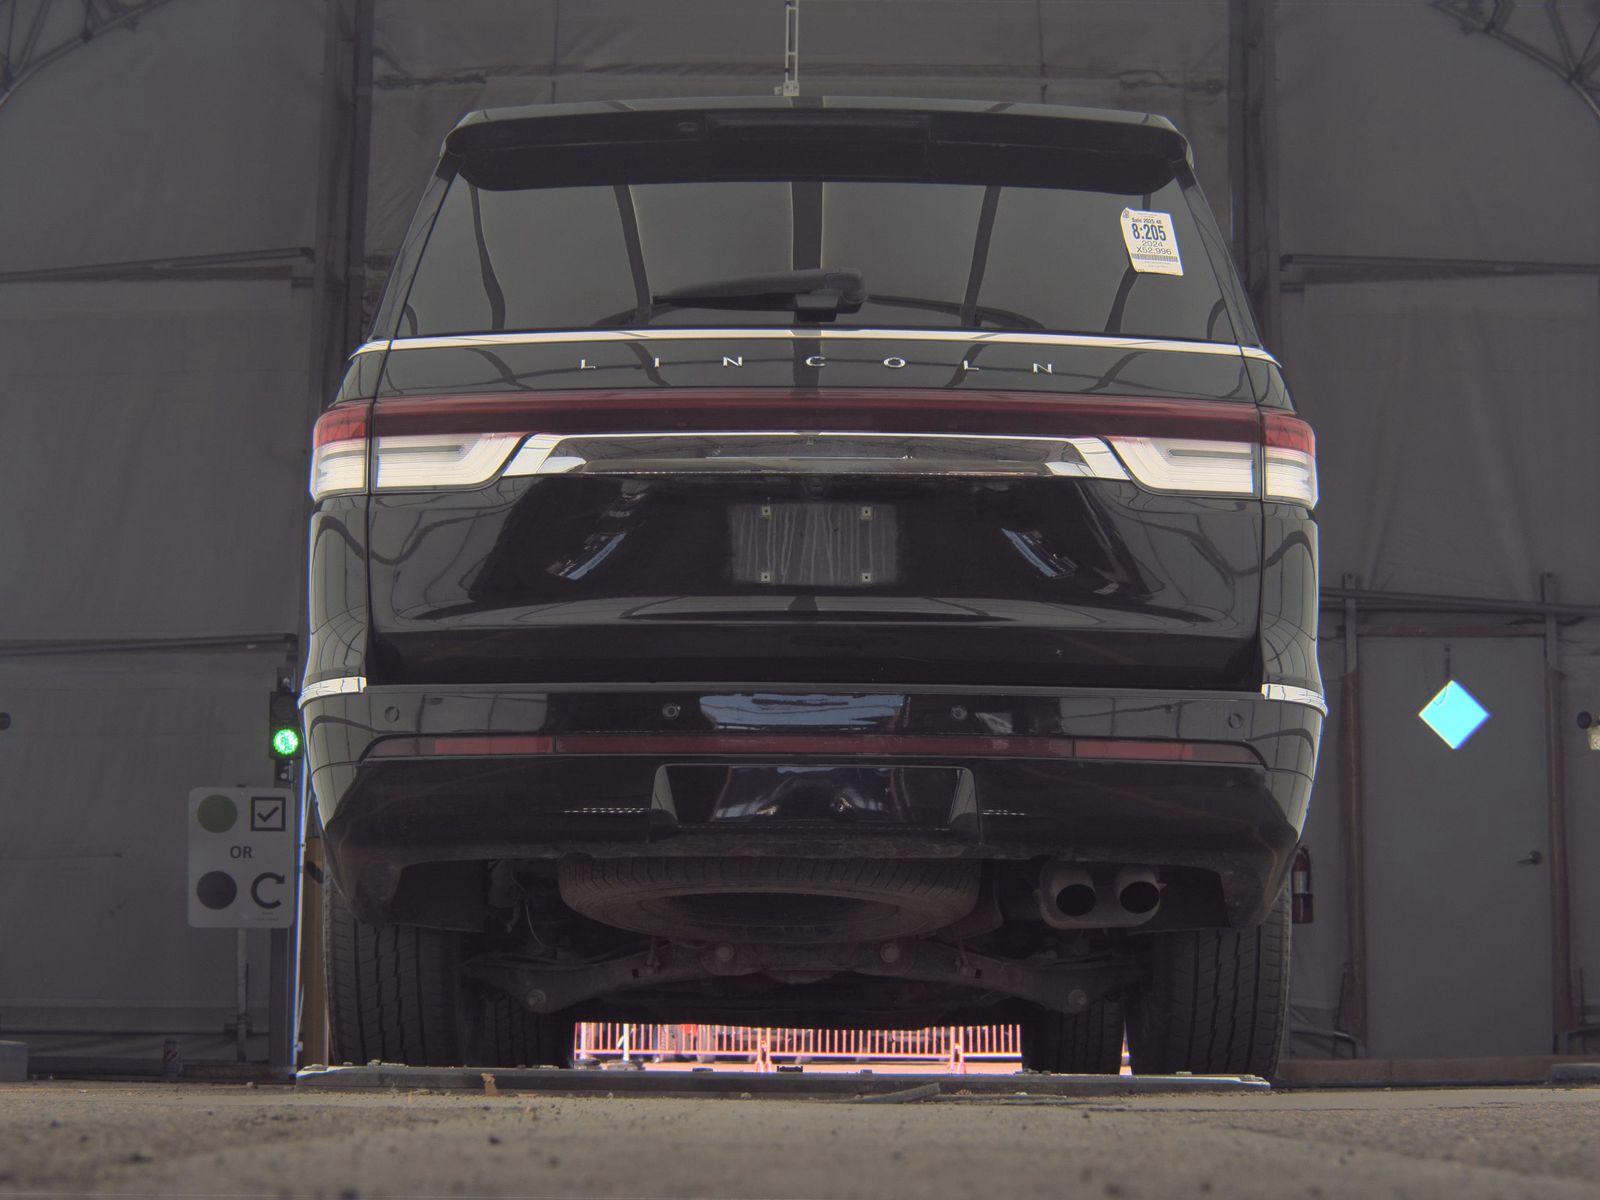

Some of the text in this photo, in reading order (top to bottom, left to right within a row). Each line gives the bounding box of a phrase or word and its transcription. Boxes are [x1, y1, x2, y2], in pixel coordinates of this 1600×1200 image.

[1131, 223, 1167, 241] 8:205
[1141, 240, 1163, 248] 2024
[580, 355, 1053, 375] LINCOLN
[229, 845, 253, 859] OR
